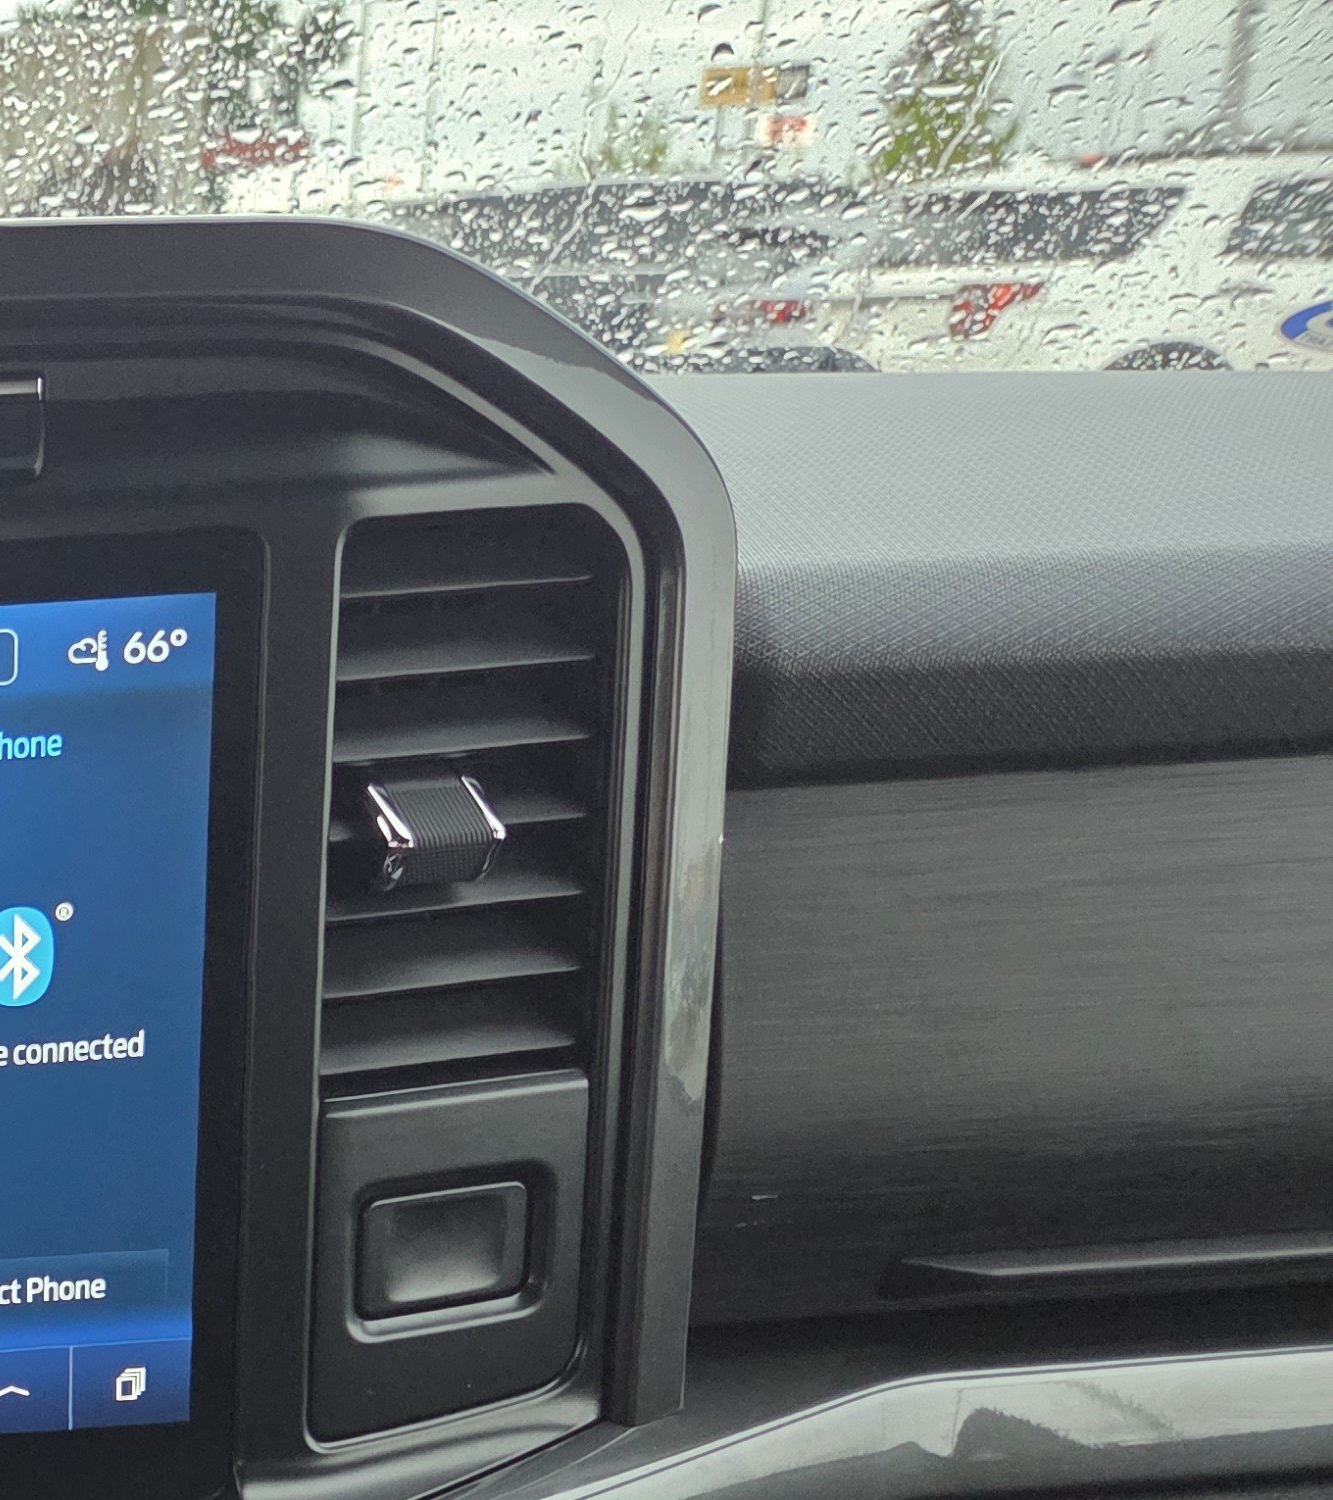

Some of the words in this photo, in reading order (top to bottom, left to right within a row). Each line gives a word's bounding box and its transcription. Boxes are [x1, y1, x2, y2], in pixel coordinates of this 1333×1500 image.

[123, 628, 187, 665] 66°
[13, 1030, 145, 1067] connected
[26, 1274, 106, 1305] Phone
